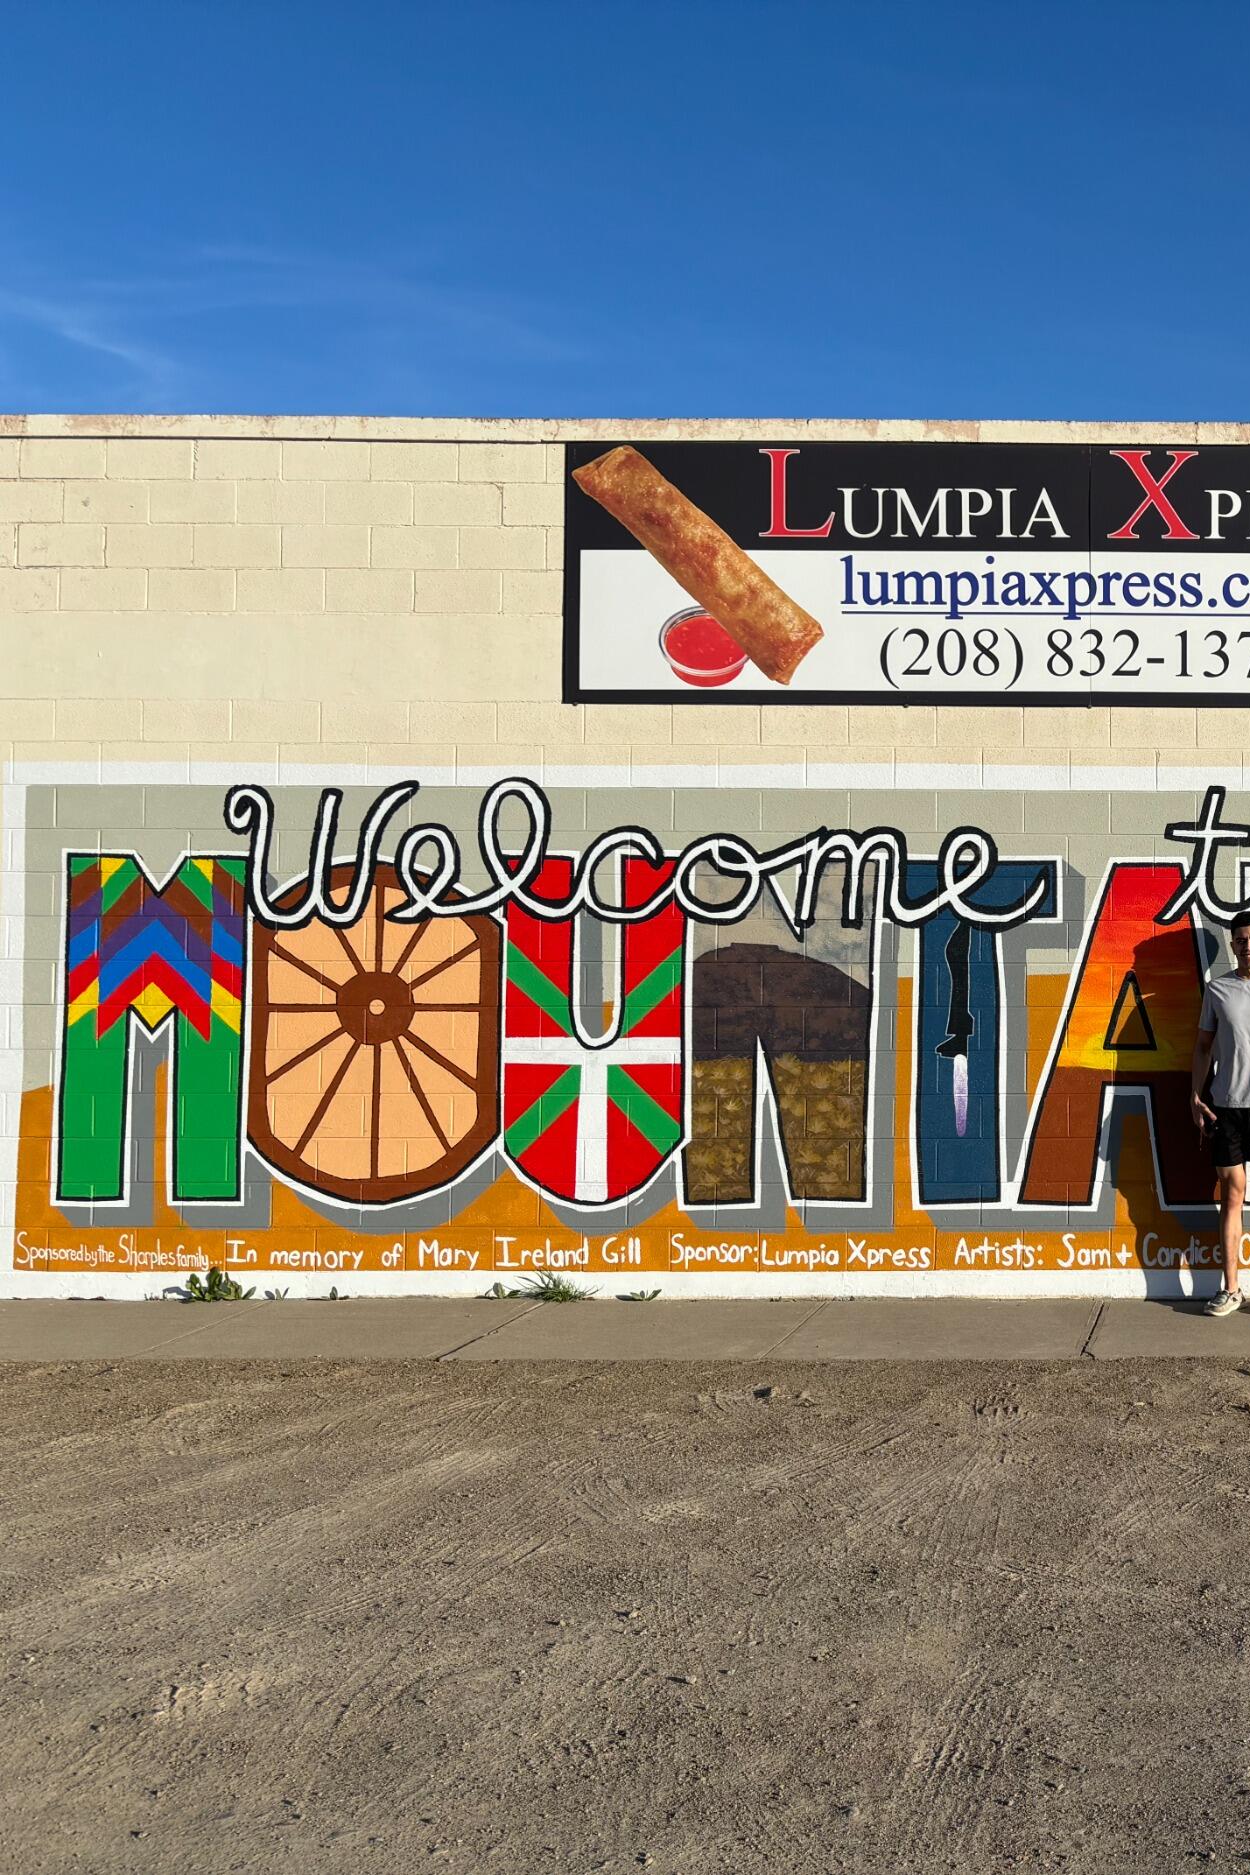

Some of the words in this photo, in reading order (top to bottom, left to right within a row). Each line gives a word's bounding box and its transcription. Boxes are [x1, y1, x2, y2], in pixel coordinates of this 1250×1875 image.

[758, 448, 1070, 538] LUMPIA
[879, 627, 1024, 690] (208)
[224, 777, 1064, 931] Welcome
[16, 1231, 84, 1269] Sponsored
[97, 1244, 115, 1263] the
[119, 1234, 176, 1267] Sharples
[226, 1239, 258, 1264] In
[269, 1249, 364, 1269] memory
[381, 1242, 403, 1268] of
[418, 1238, 480, 1270] Mary
[495, 1236, 590, 1268] Ireland
[602, 1236, 642, 1265] Gill
[670, 1232, 760, 1270] Sponsor:
[761, 1239, 840, 1271] Lumpia
[847, 1238, 932, 1270] Xpress
[953, 1236, 1044, 1269] Artists:
[1056, 1232, 1112, 1269] Sam
[1142, 1232, 1224, 1267] Candice
